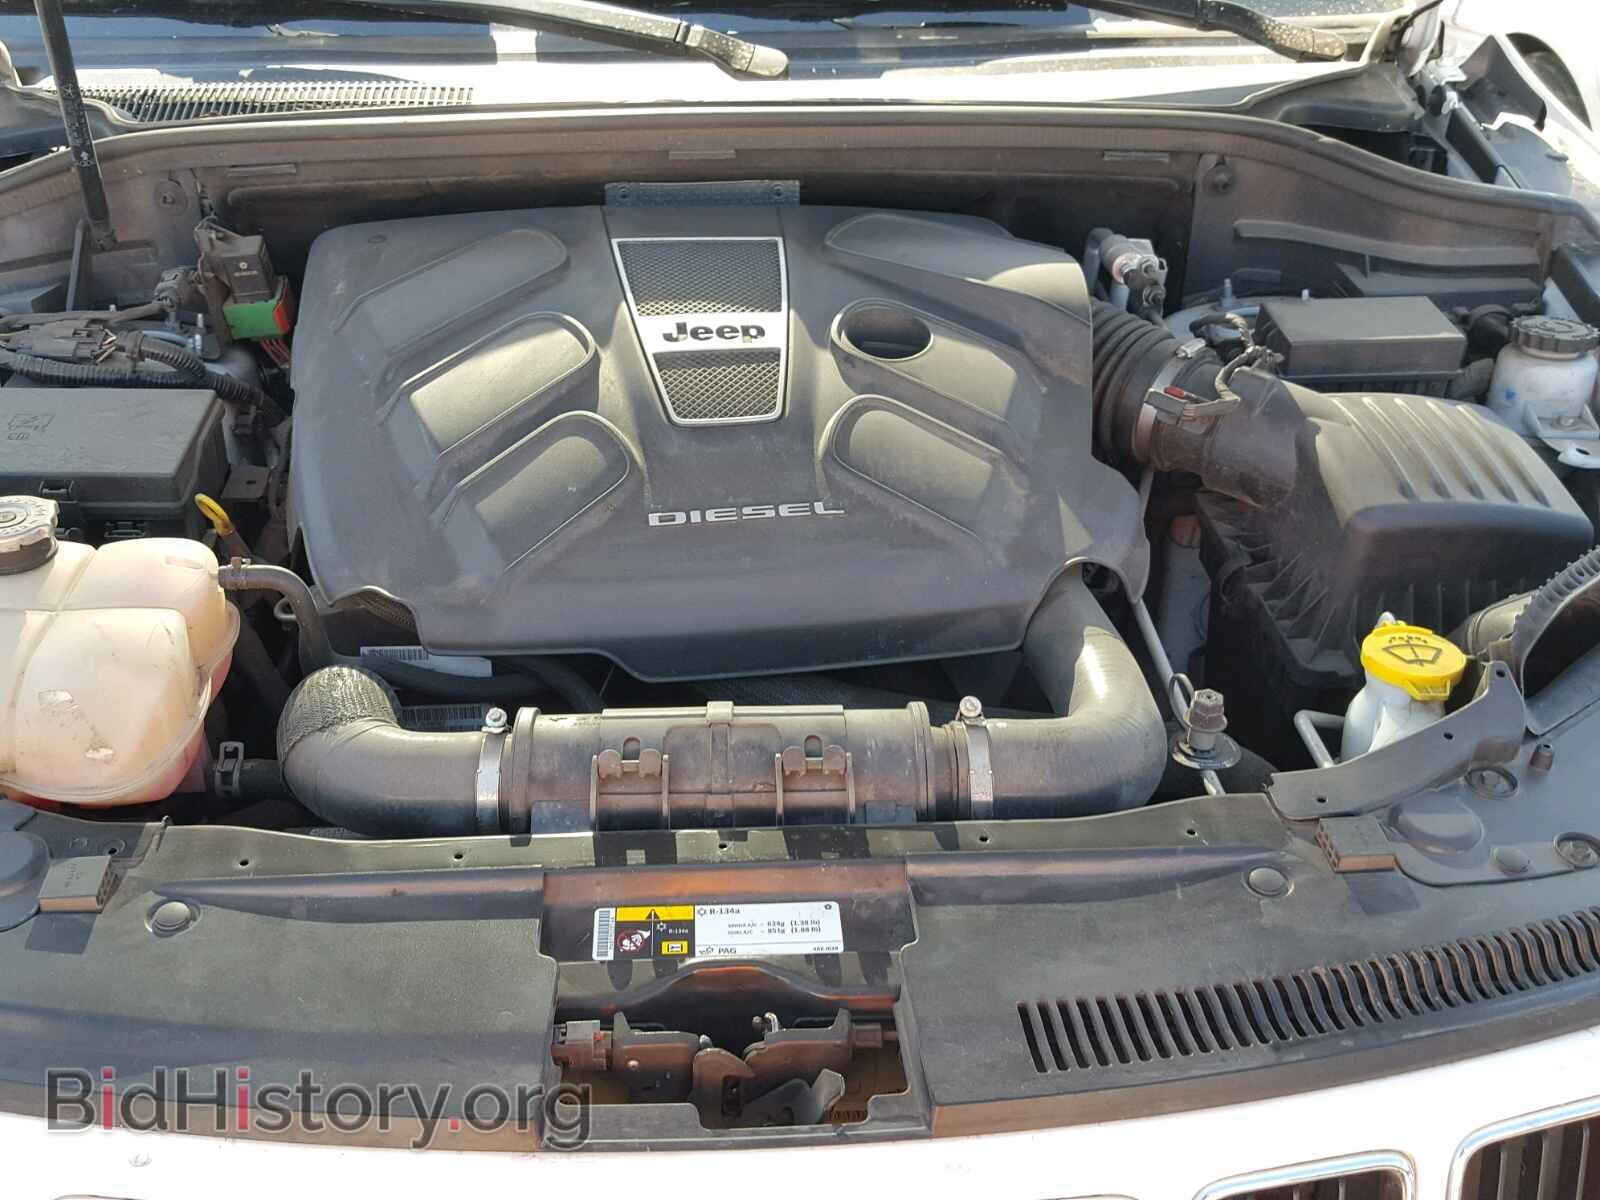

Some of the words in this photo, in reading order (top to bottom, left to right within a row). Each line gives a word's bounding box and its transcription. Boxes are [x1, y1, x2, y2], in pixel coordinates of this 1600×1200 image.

[662, 322, 766, 343] Jeep
[648, 501, 846, 526] DIESEL
[709, 907, 741, 915] R-134a
[718, 946, 737, 955] PAG
